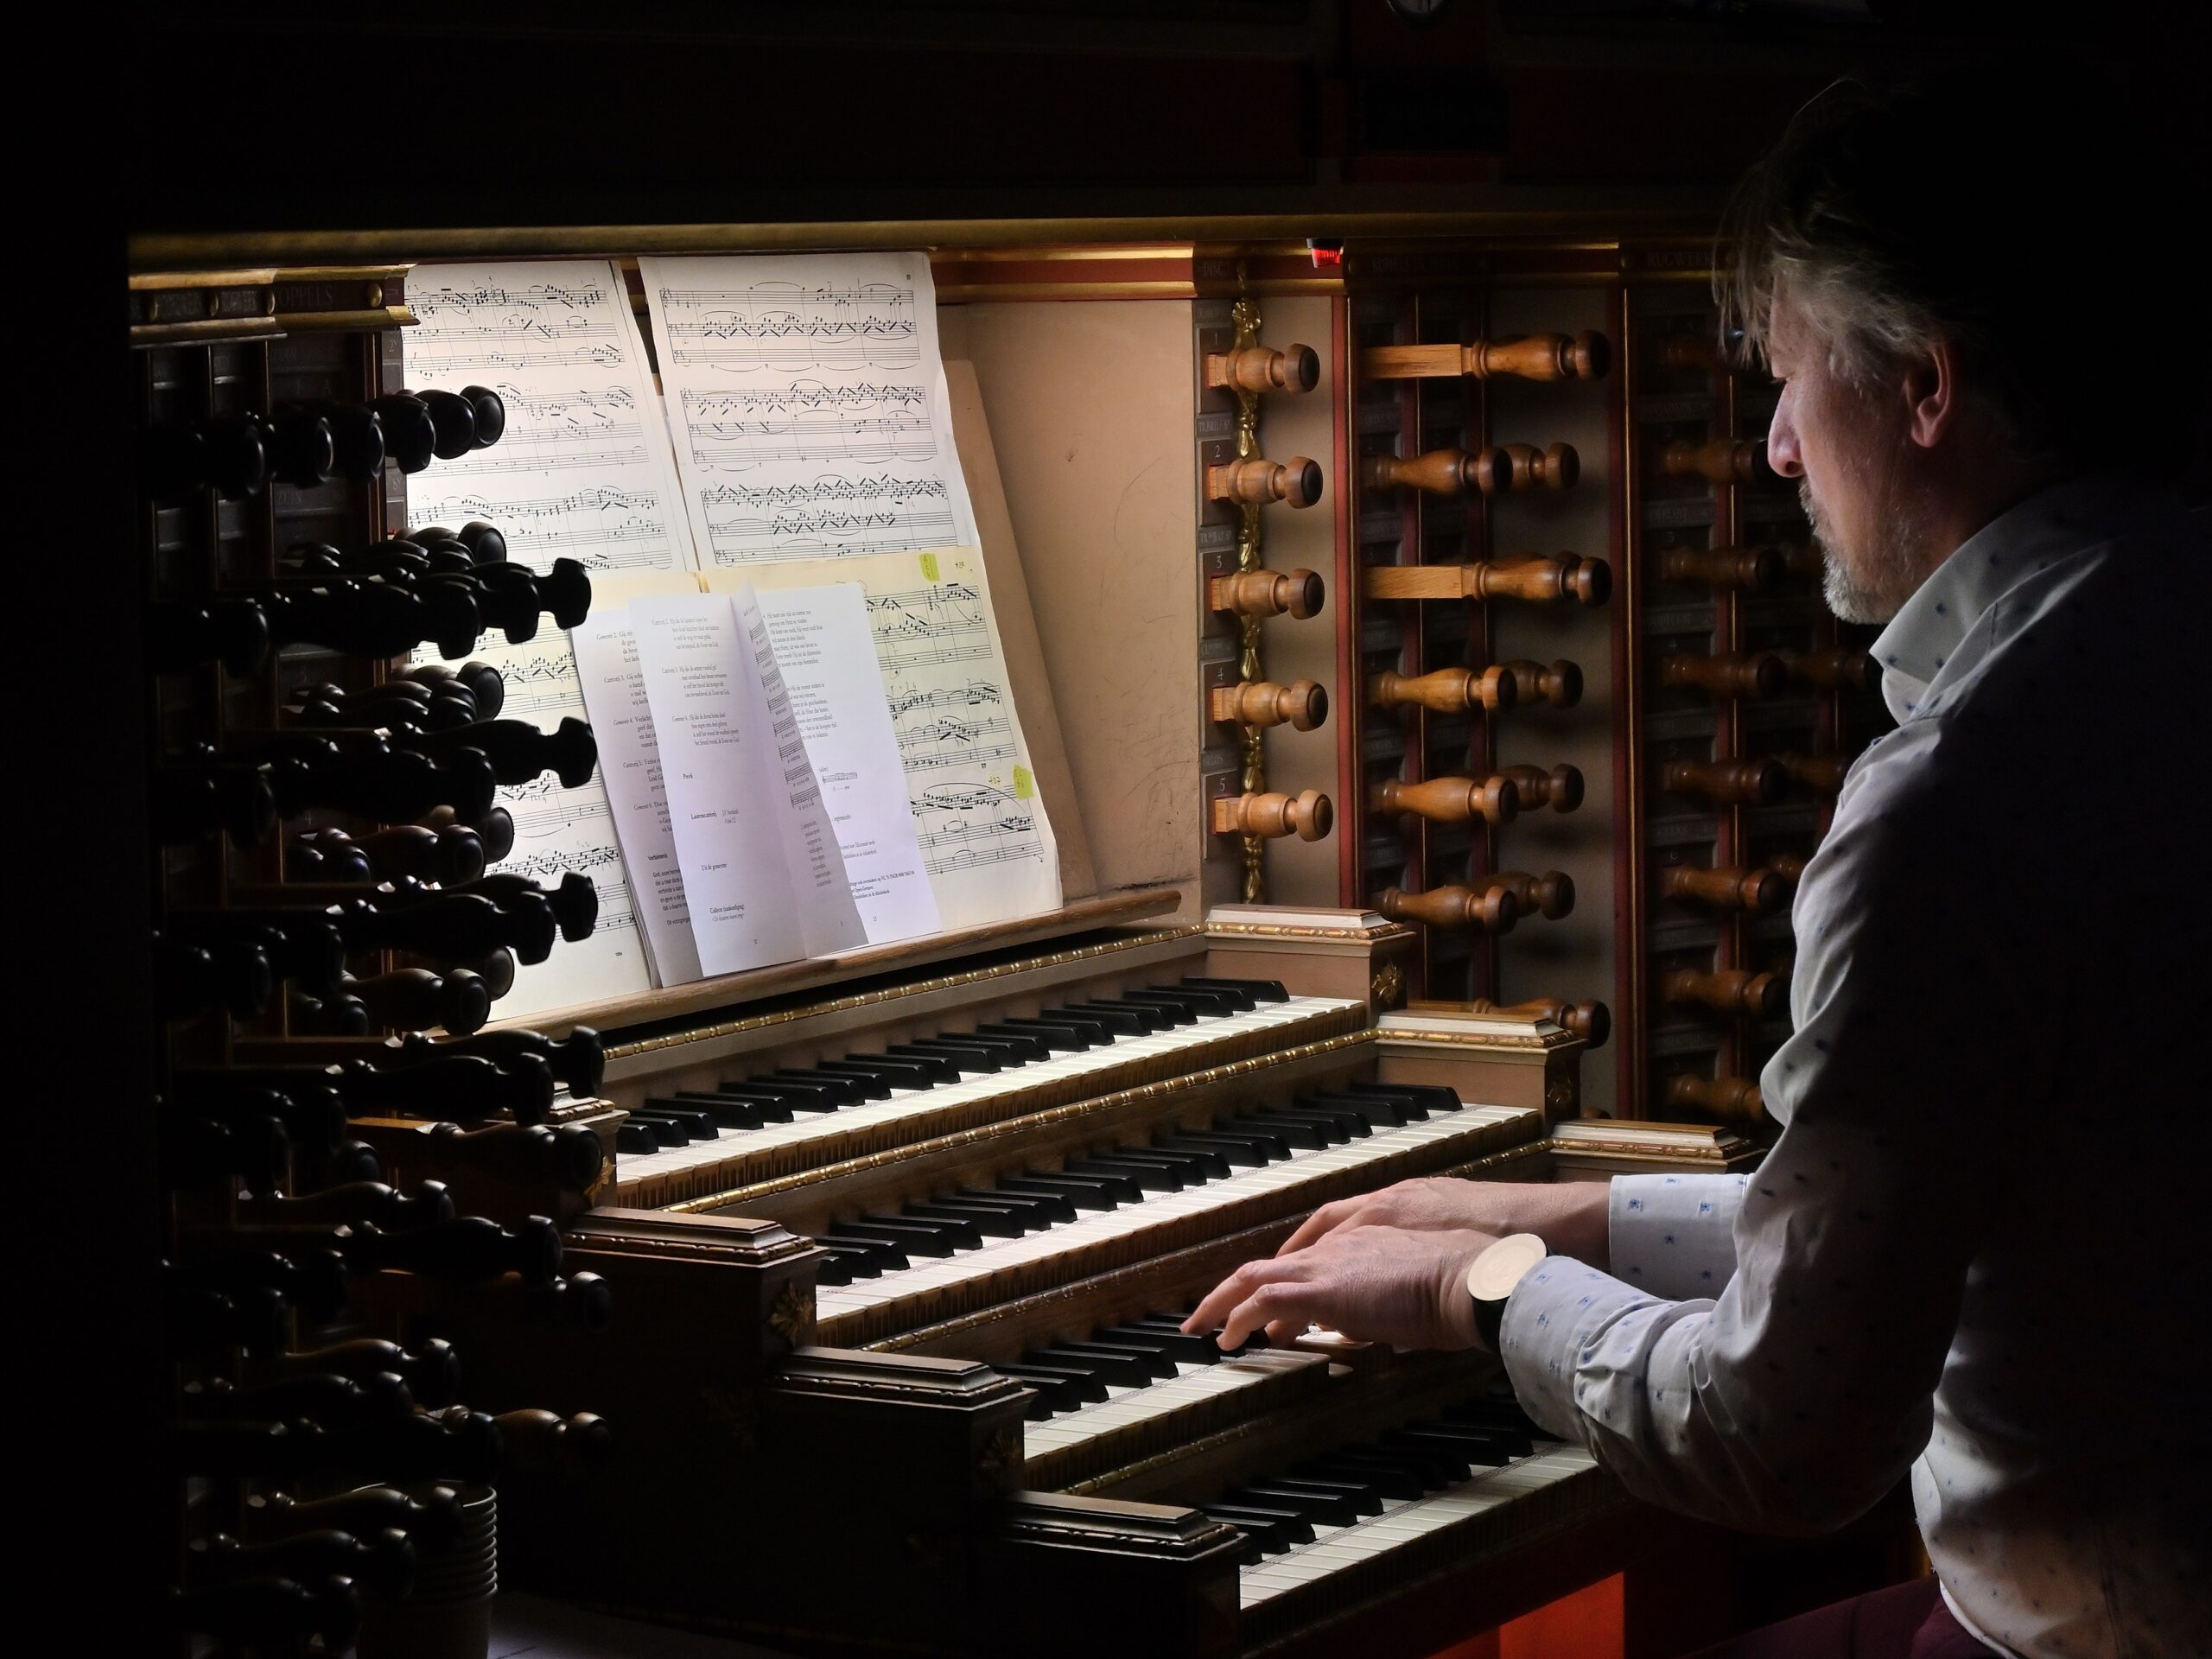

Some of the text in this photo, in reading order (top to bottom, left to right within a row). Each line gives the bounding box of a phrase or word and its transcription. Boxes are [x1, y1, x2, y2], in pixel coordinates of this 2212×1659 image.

[278, 284, 333, 308] OPPELS
[1214, 444, 1221, 458] 2
[1216, 555, 1223, 569] 3
[1217, 667, 1224, 681] 4
[1219, 690, 1226, 706] 5
